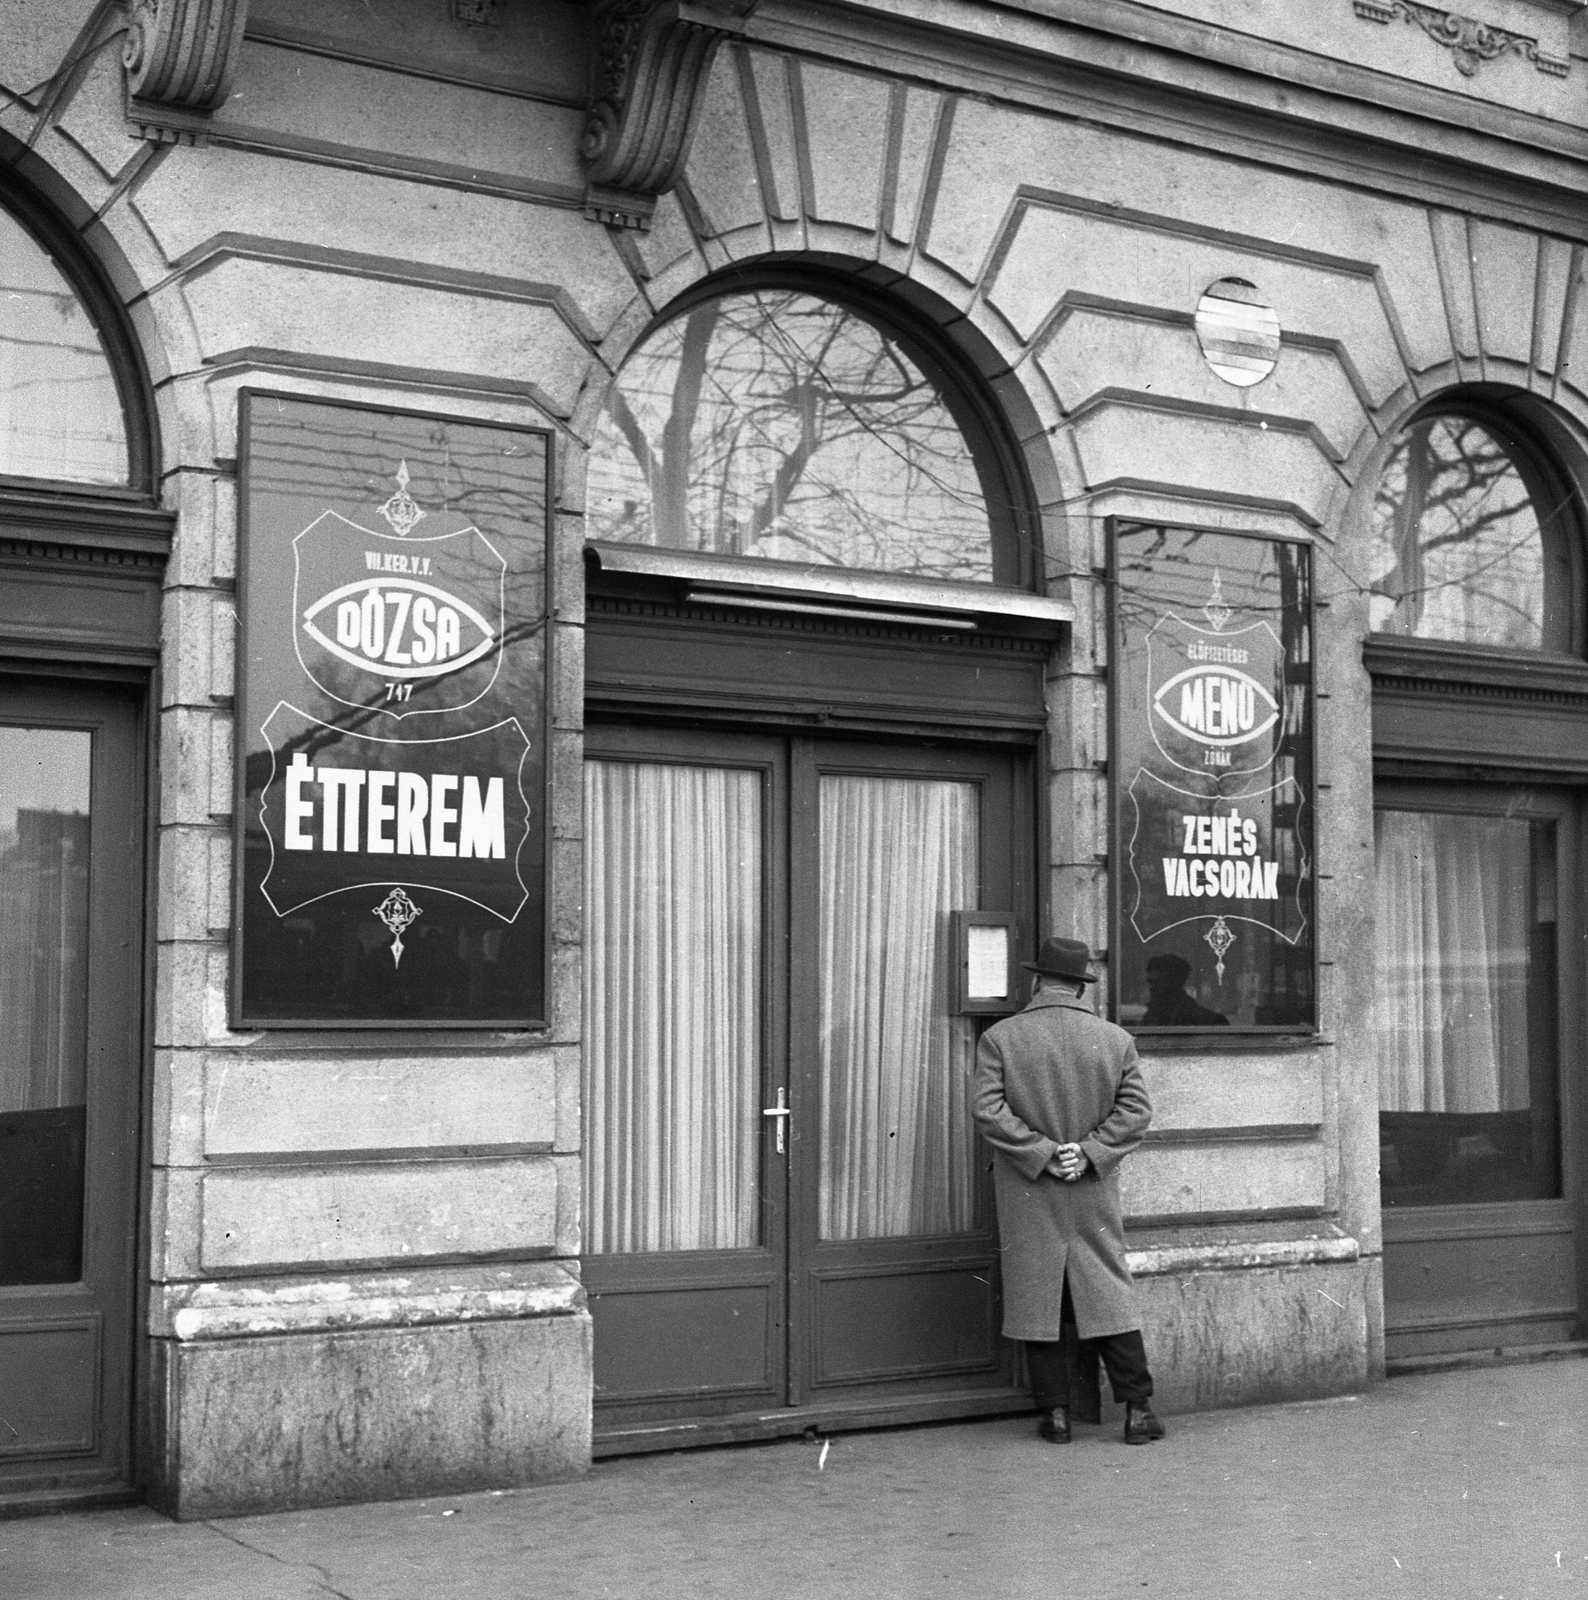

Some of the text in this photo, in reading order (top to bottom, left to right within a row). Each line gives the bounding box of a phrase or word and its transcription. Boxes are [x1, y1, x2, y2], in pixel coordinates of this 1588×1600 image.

[337, 587, 460, 664] DÓZSA
[285, 752, 506, 859] ÉTTEREM
[1183, 808, 1257, 856] ZENÉS
[1162, 855, 1279, 899] VACSORÁK
